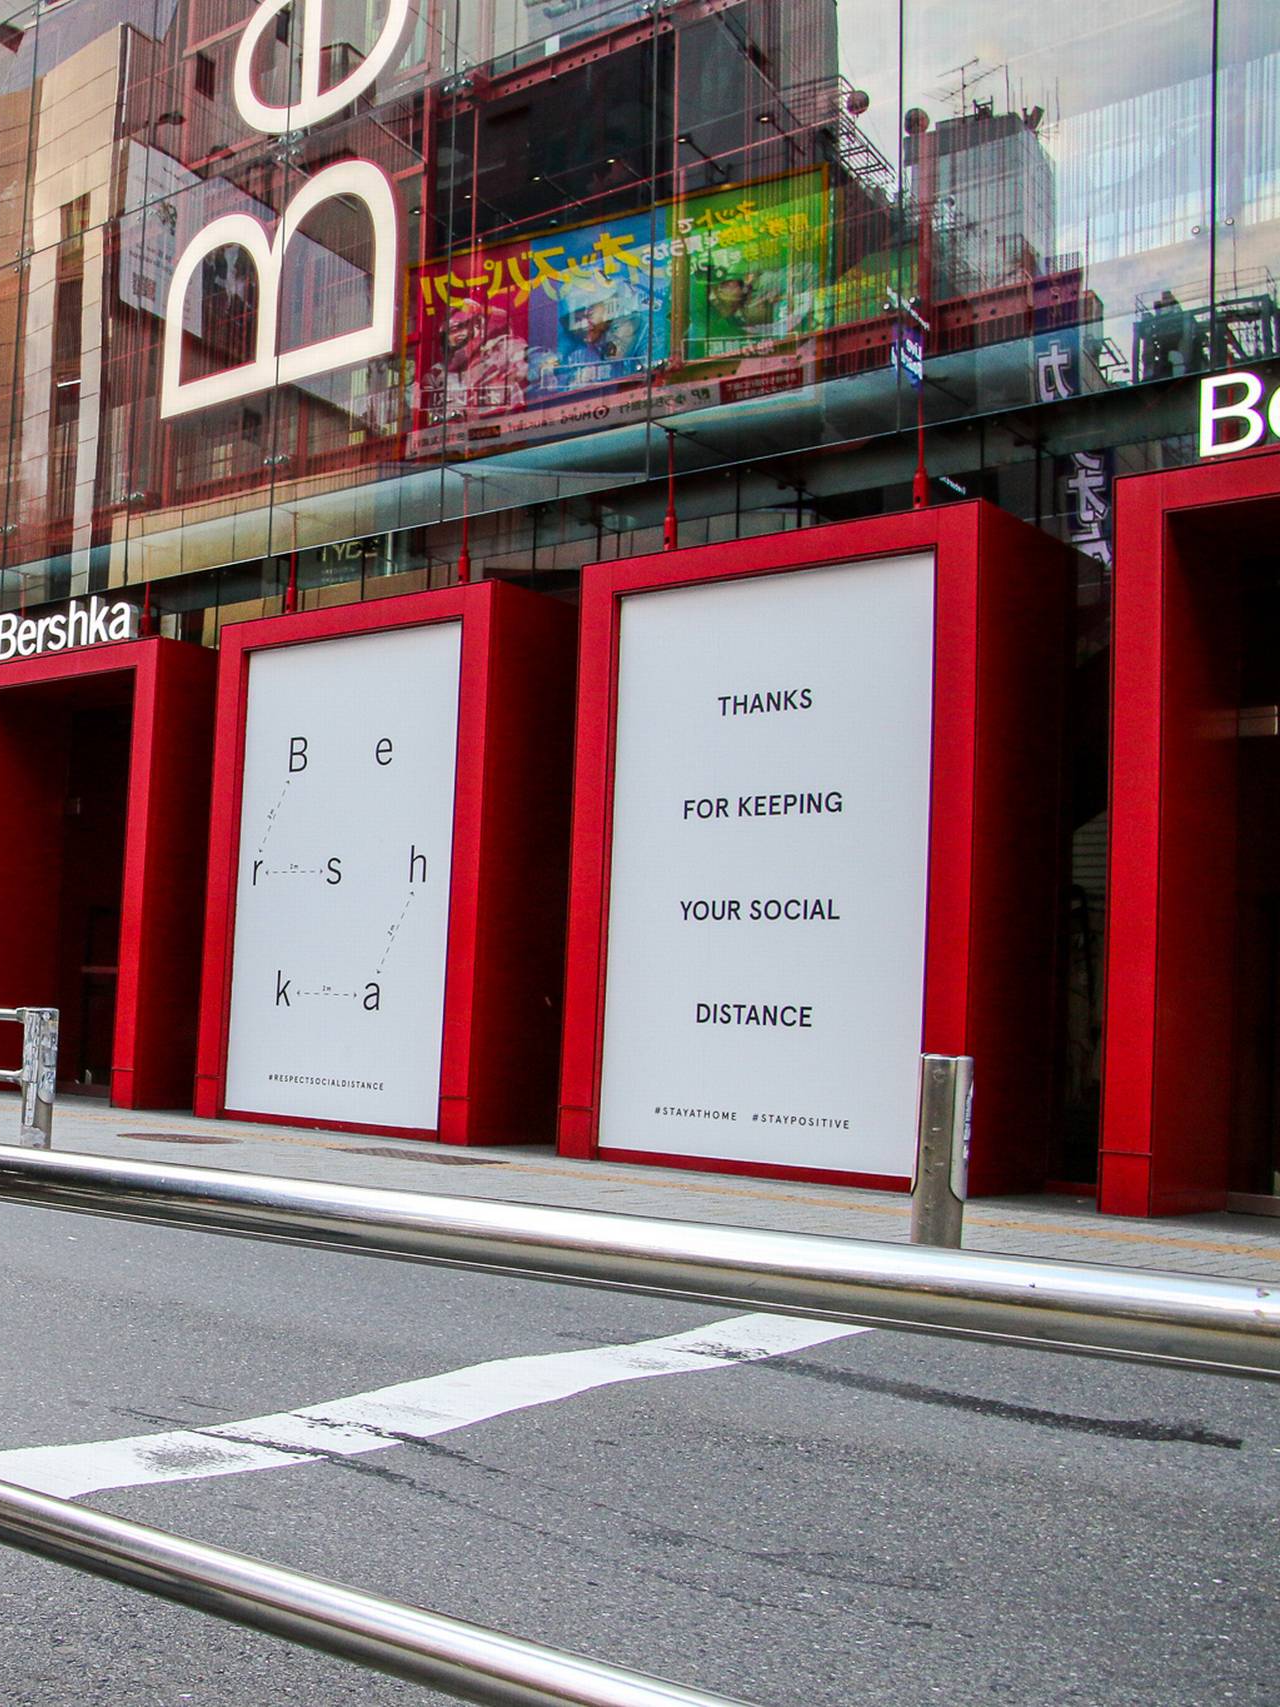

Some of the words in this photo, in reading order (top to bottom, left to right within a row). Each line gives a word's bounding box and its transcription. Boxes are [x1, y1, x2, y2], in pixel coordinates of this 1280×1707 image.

[1199, 372, 1280, 457] B
[718, 688, 813, 717] THANKS
[288, 736, 308, 773] B
[375, 737, 393, 766] e
[683, 797, 729, 820] FOR
[738, 791, 843, 817] KEEPING
[252, 857, 264, 886] r
[326, 857, 342, 885] s
[409, 844, 427, 883] h
[680, 900, 741, 921] YOUR
[749, 898, 841, 921] SOCIAL
[275, 969, 291, 1007] k
[363, 982, 380, 1011] a
[696, 1003, 813, 1028] DISTANCE
[268, 1074, 384, 1091] #RESPECTSOCIALDISTANCE
[655, 1107, 737, 1121] #STAYATHOME
[752, 1113, 849, 1130] #STAYPOSITIVE
